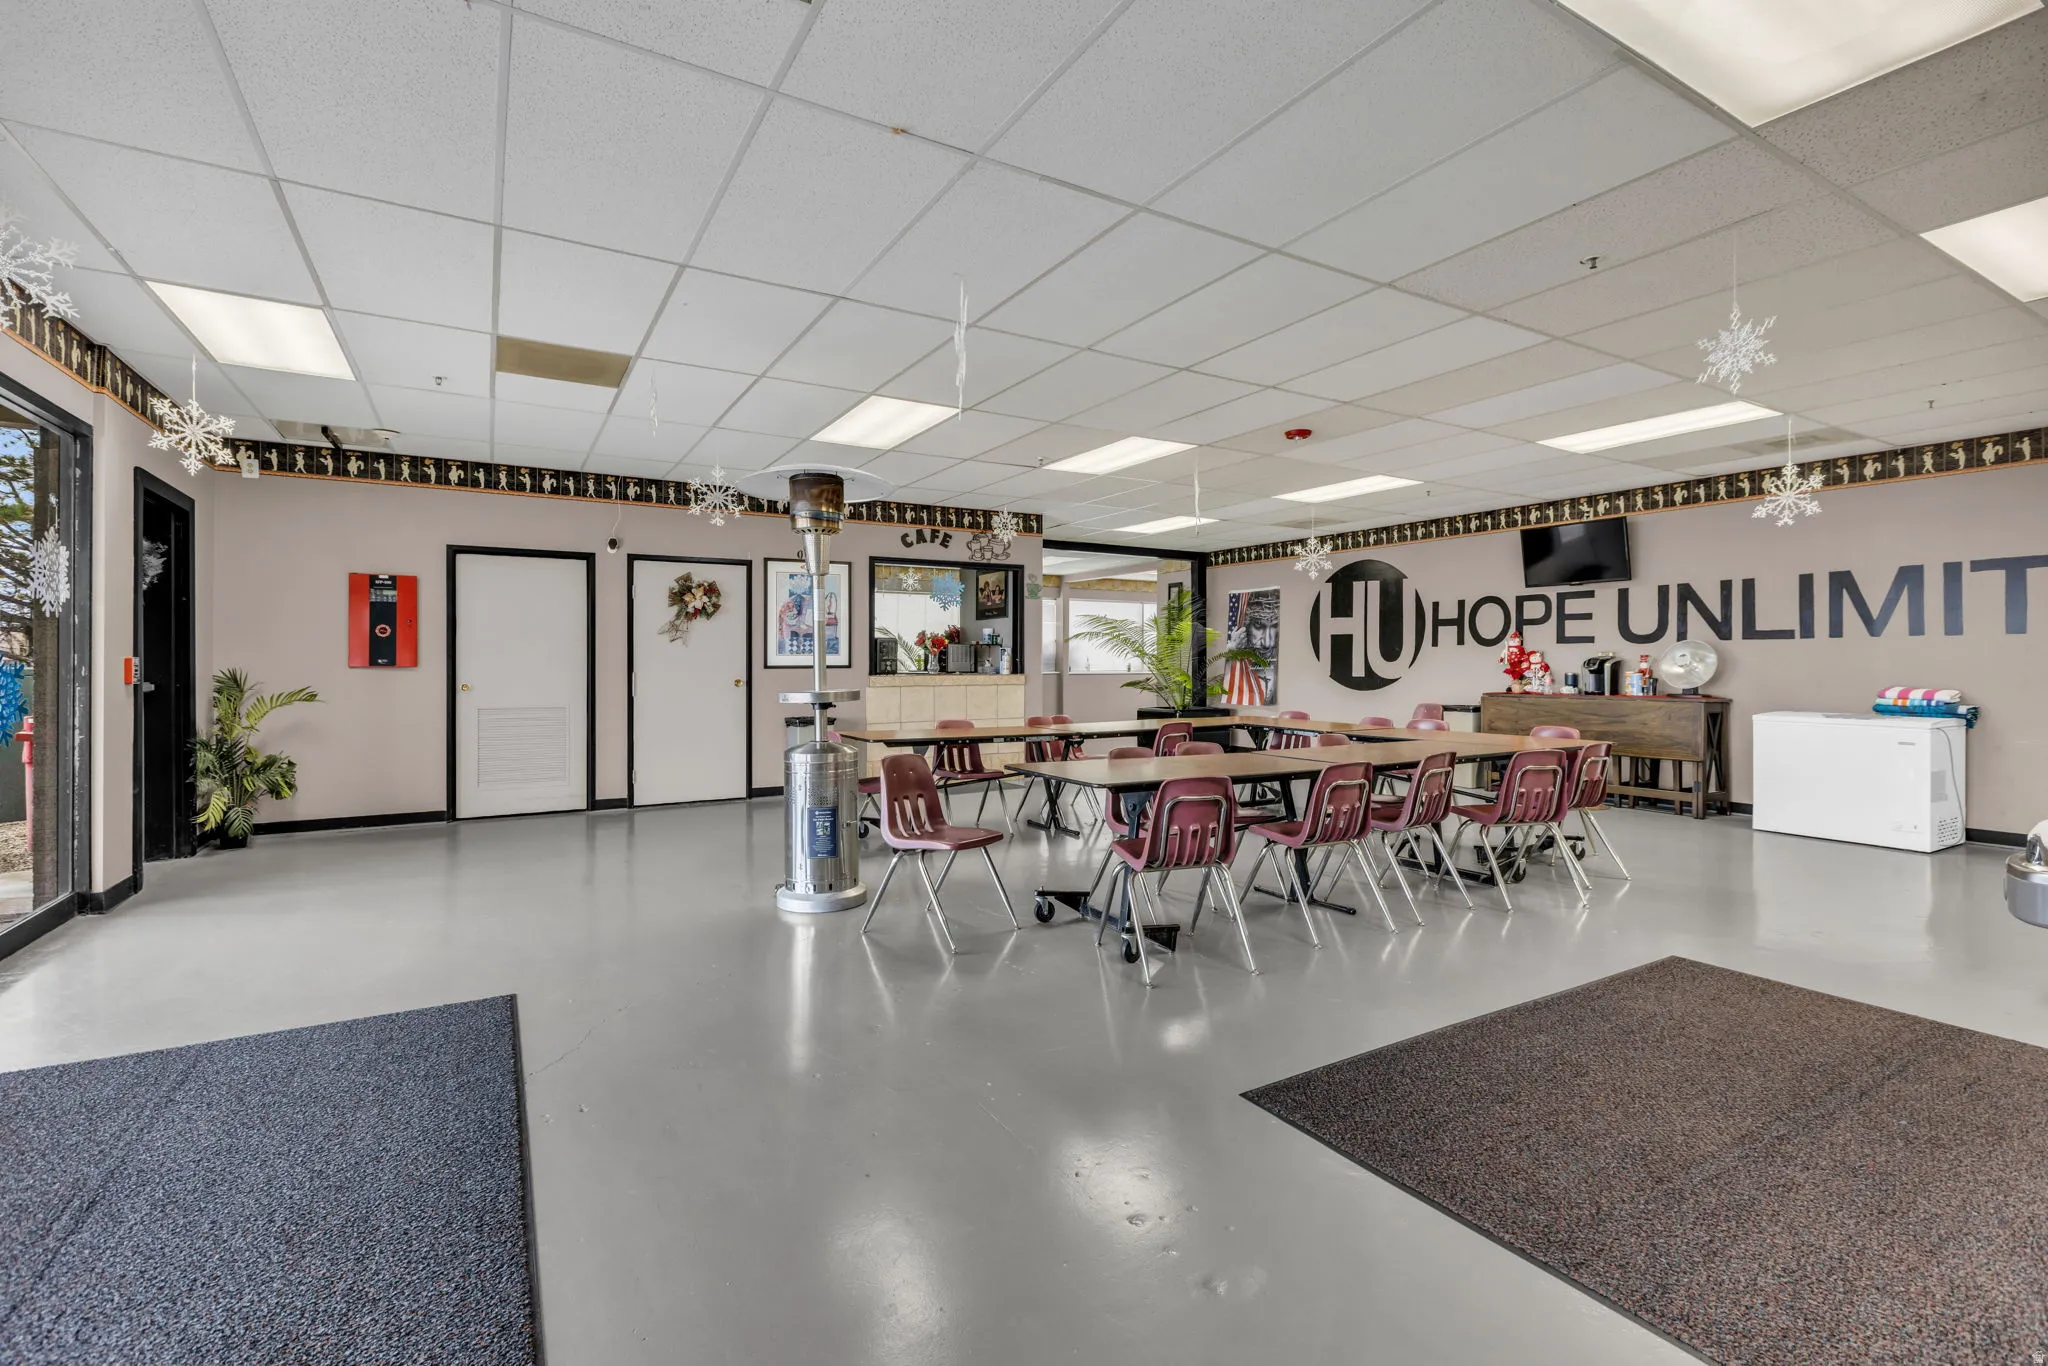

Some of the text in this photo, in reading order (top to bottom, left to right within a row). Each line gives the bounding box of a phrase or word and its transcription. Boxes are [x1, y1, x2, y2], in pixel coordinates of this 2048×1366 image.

[900, 528, 953, 549] CAFE
[1318, 577, 1417, 681] HU
[1431, 554, 2048, 648] HOPE UNLIMIT
